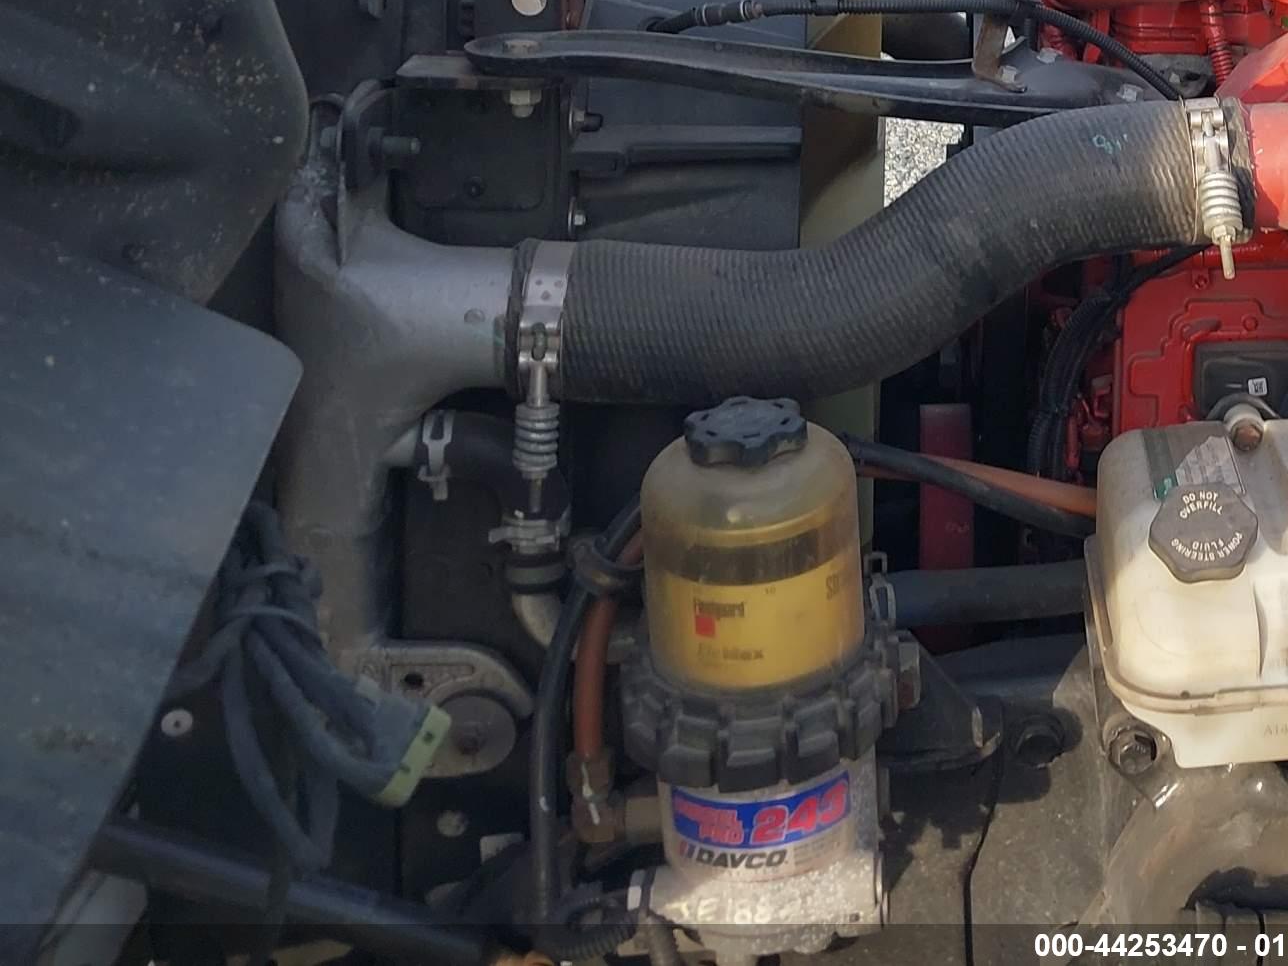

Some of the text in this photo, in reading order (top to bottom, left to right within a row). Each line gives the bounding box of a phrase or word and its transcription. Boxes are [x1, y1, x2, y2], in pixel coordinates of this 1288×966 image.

[1182, 490, 1219, 504] DO NOT
[1179, 500, 1223, 519] OVERFILL
[1171, 532, 1242, 561] POWER STEERING
[1192, 538, 1225, 551] FLUID
[695, 848, 783, 869] DAVCO
